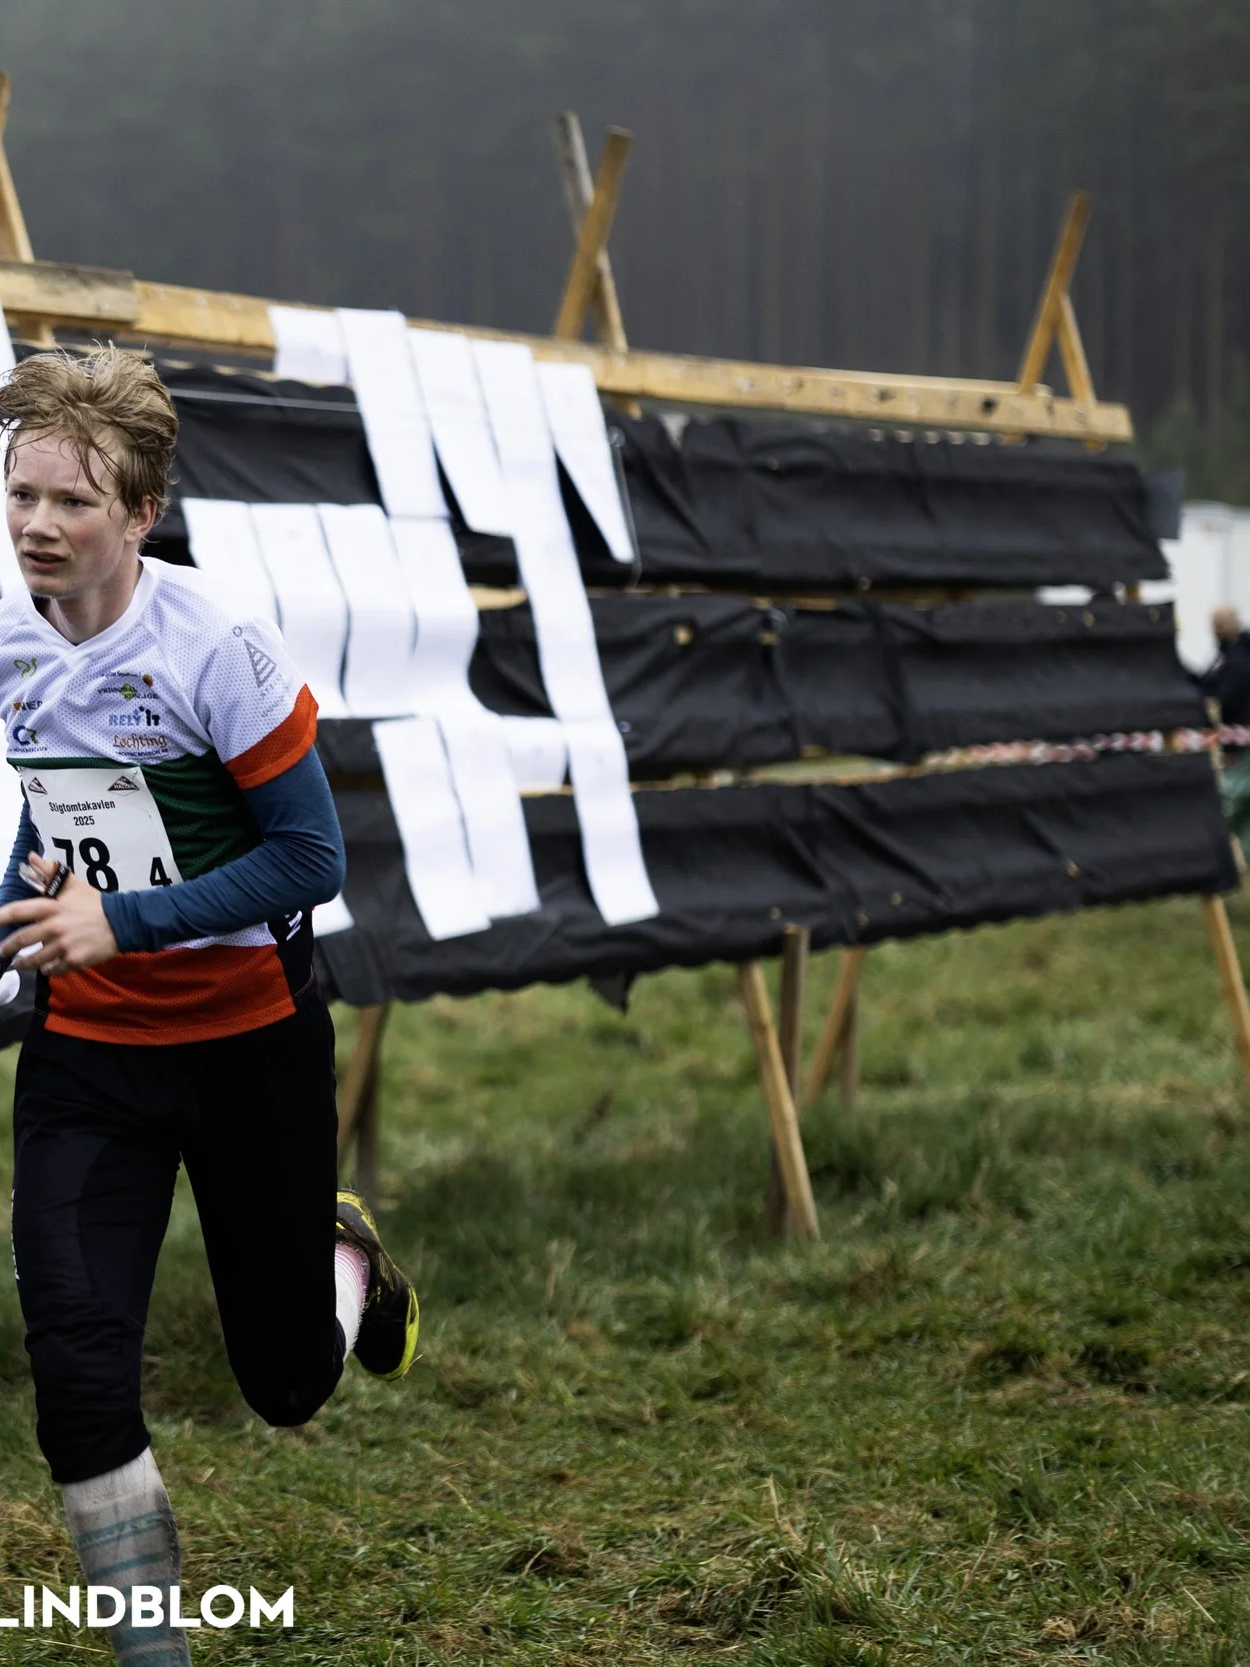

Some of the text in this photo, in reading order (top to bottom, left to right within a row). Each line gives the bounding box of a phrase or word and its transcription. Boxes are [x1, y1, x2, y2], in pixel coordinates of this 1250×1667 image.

[49, 800, 116, 814] Stigtomtakavlen
[73, 815, 95, 826] 2025
[51, 837, 119, 893] 78
[150, 857, 172, 887] 4
